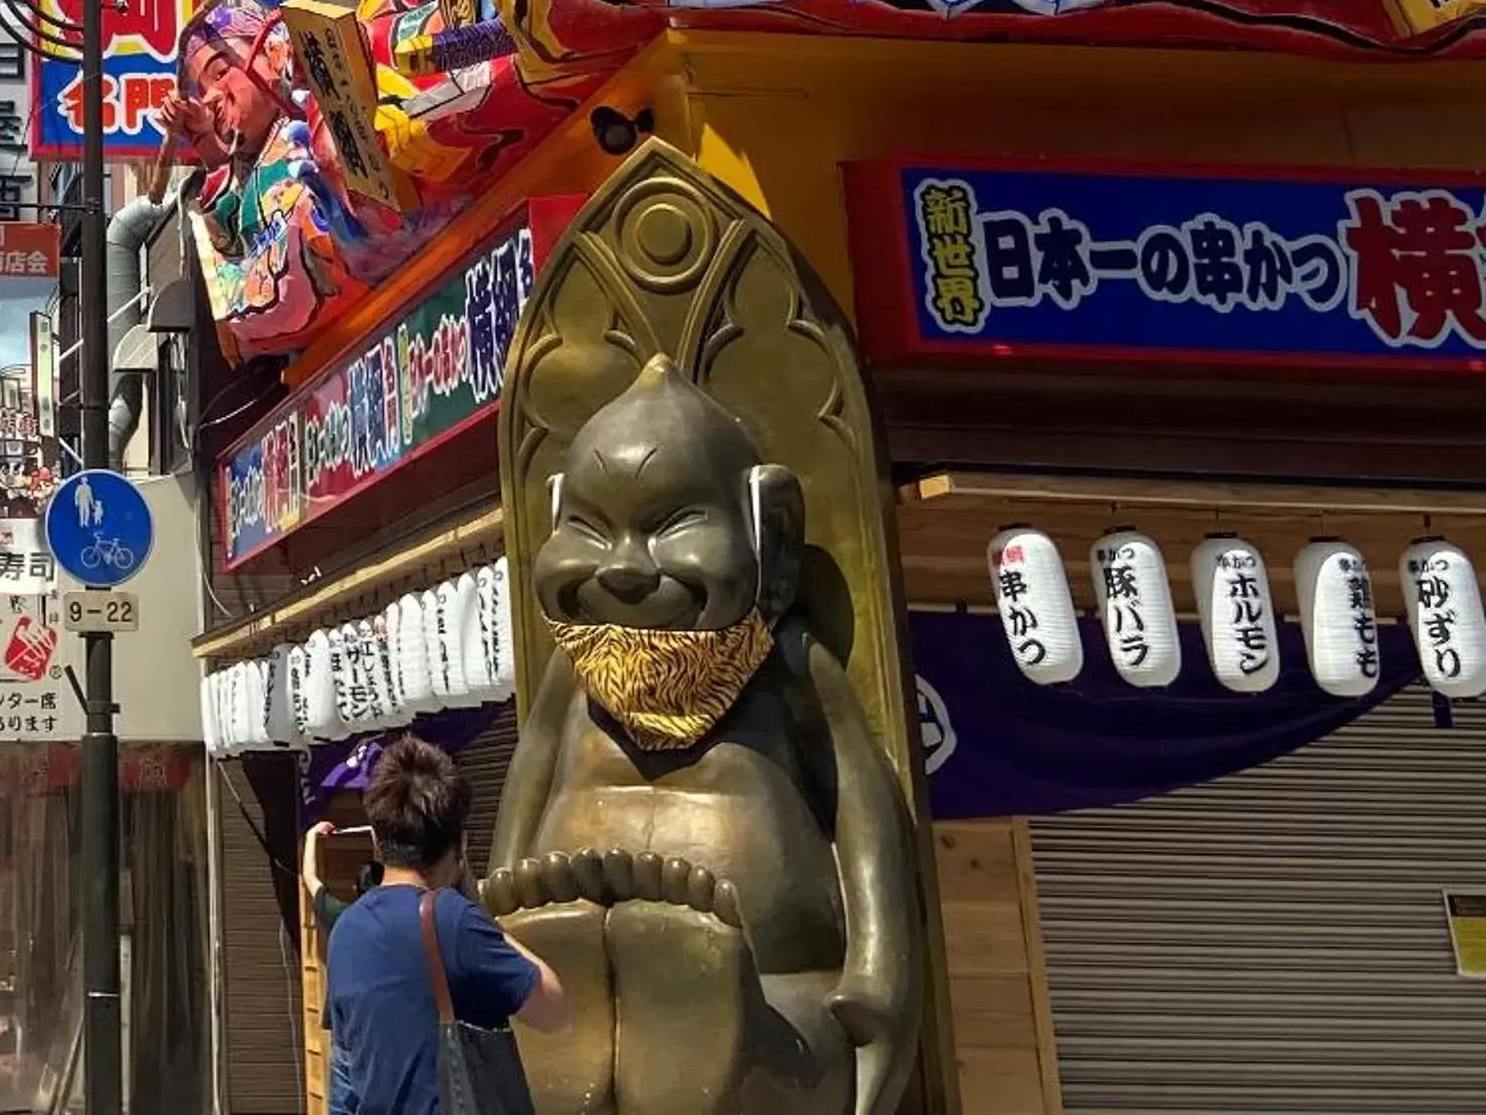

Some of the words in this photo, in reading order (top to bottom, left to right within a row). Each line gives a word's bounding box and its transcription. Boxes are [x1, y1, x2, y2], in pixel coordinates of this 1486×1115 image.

[923, 185, 982, 326] 新世界
[981, 219, 1342, 306] 日本一の串かつ
[1345, 195, 1486, 342] 横
[69, 601, 133, 623] 9-22
[998, 570, 1046, 666] 串かつ
[1103, 565, 1150, 667] 豚バラ
[1226, 573, 1271, 676] ホルモン
[1417, 575, 1462, 679] 砂ずり
